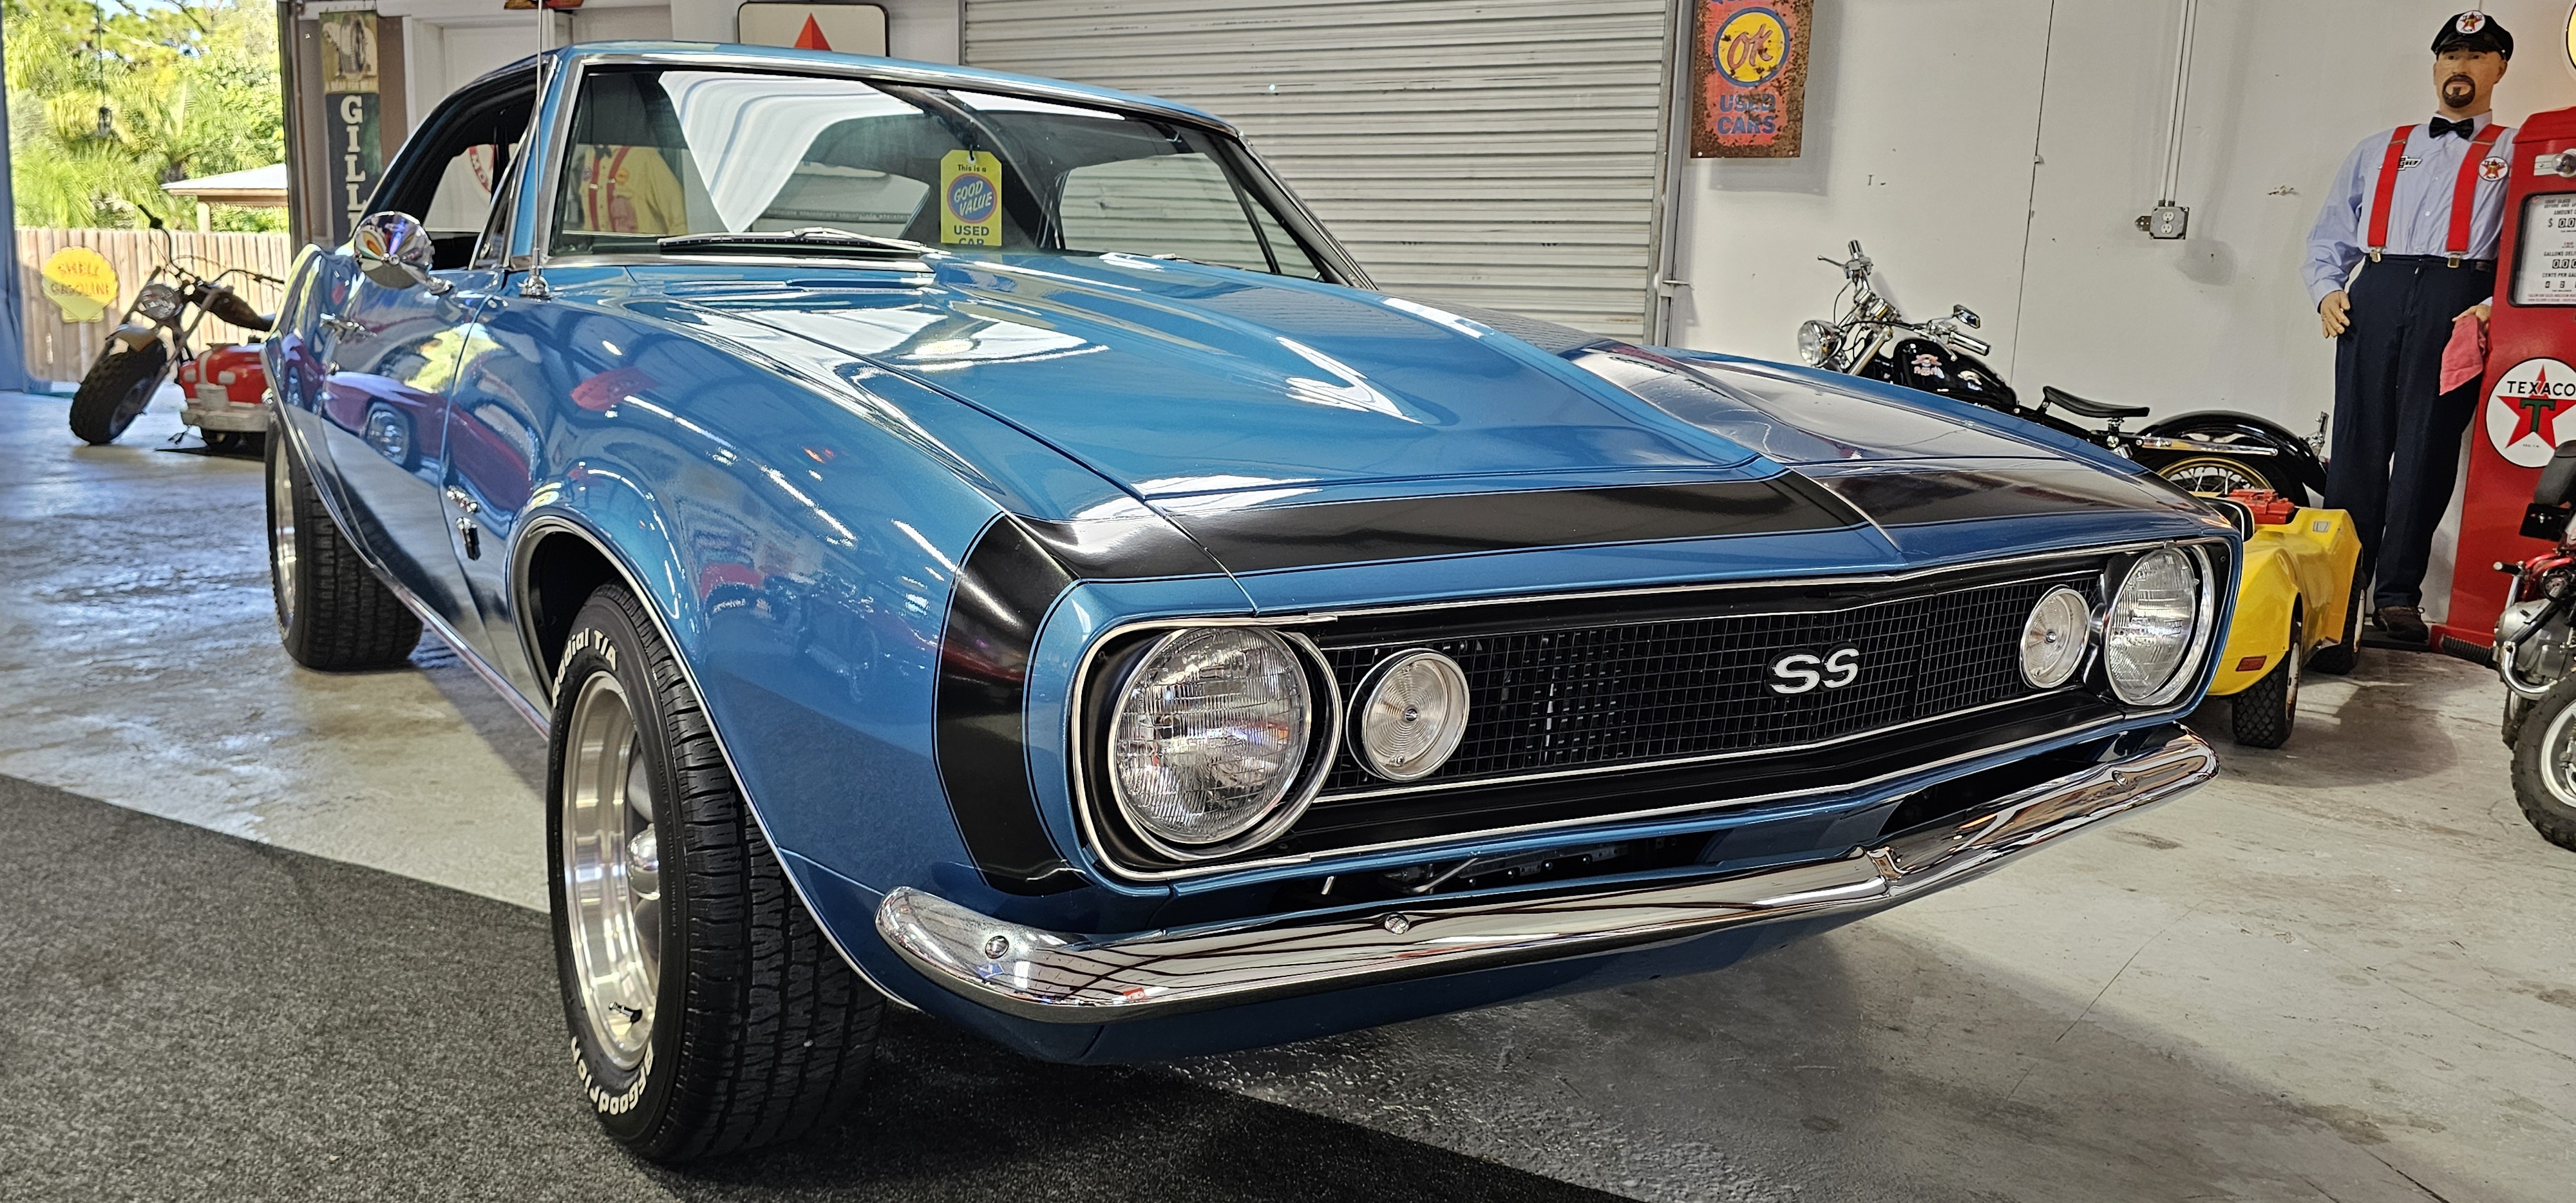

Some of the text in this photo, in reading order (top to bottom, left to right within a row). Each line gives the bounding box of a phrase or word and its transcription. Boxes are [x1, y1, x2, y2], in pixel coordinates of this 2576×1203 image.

[1719, 93, 1776, 112] USED
[1718, 115, 1776, 134] CARS
[341, 95, 367, 237] GILL
[954, 180, 983, 203] GOOD
[960, 191, 992, 216] VALUE
[954, 225, 990, 236] USED
[58, 262, 100, 278] SHELL
[51, 282, 109, 297] GASOLINE
[2507, 381, 2576, 397] TEXACO
[2519, 397, 2557, 433] T
[552, 627, 616, 709] Radial T/A
[1768, 646, 1860, 694] SS
[571, 1036, 654, 1115] BFGoodrich
